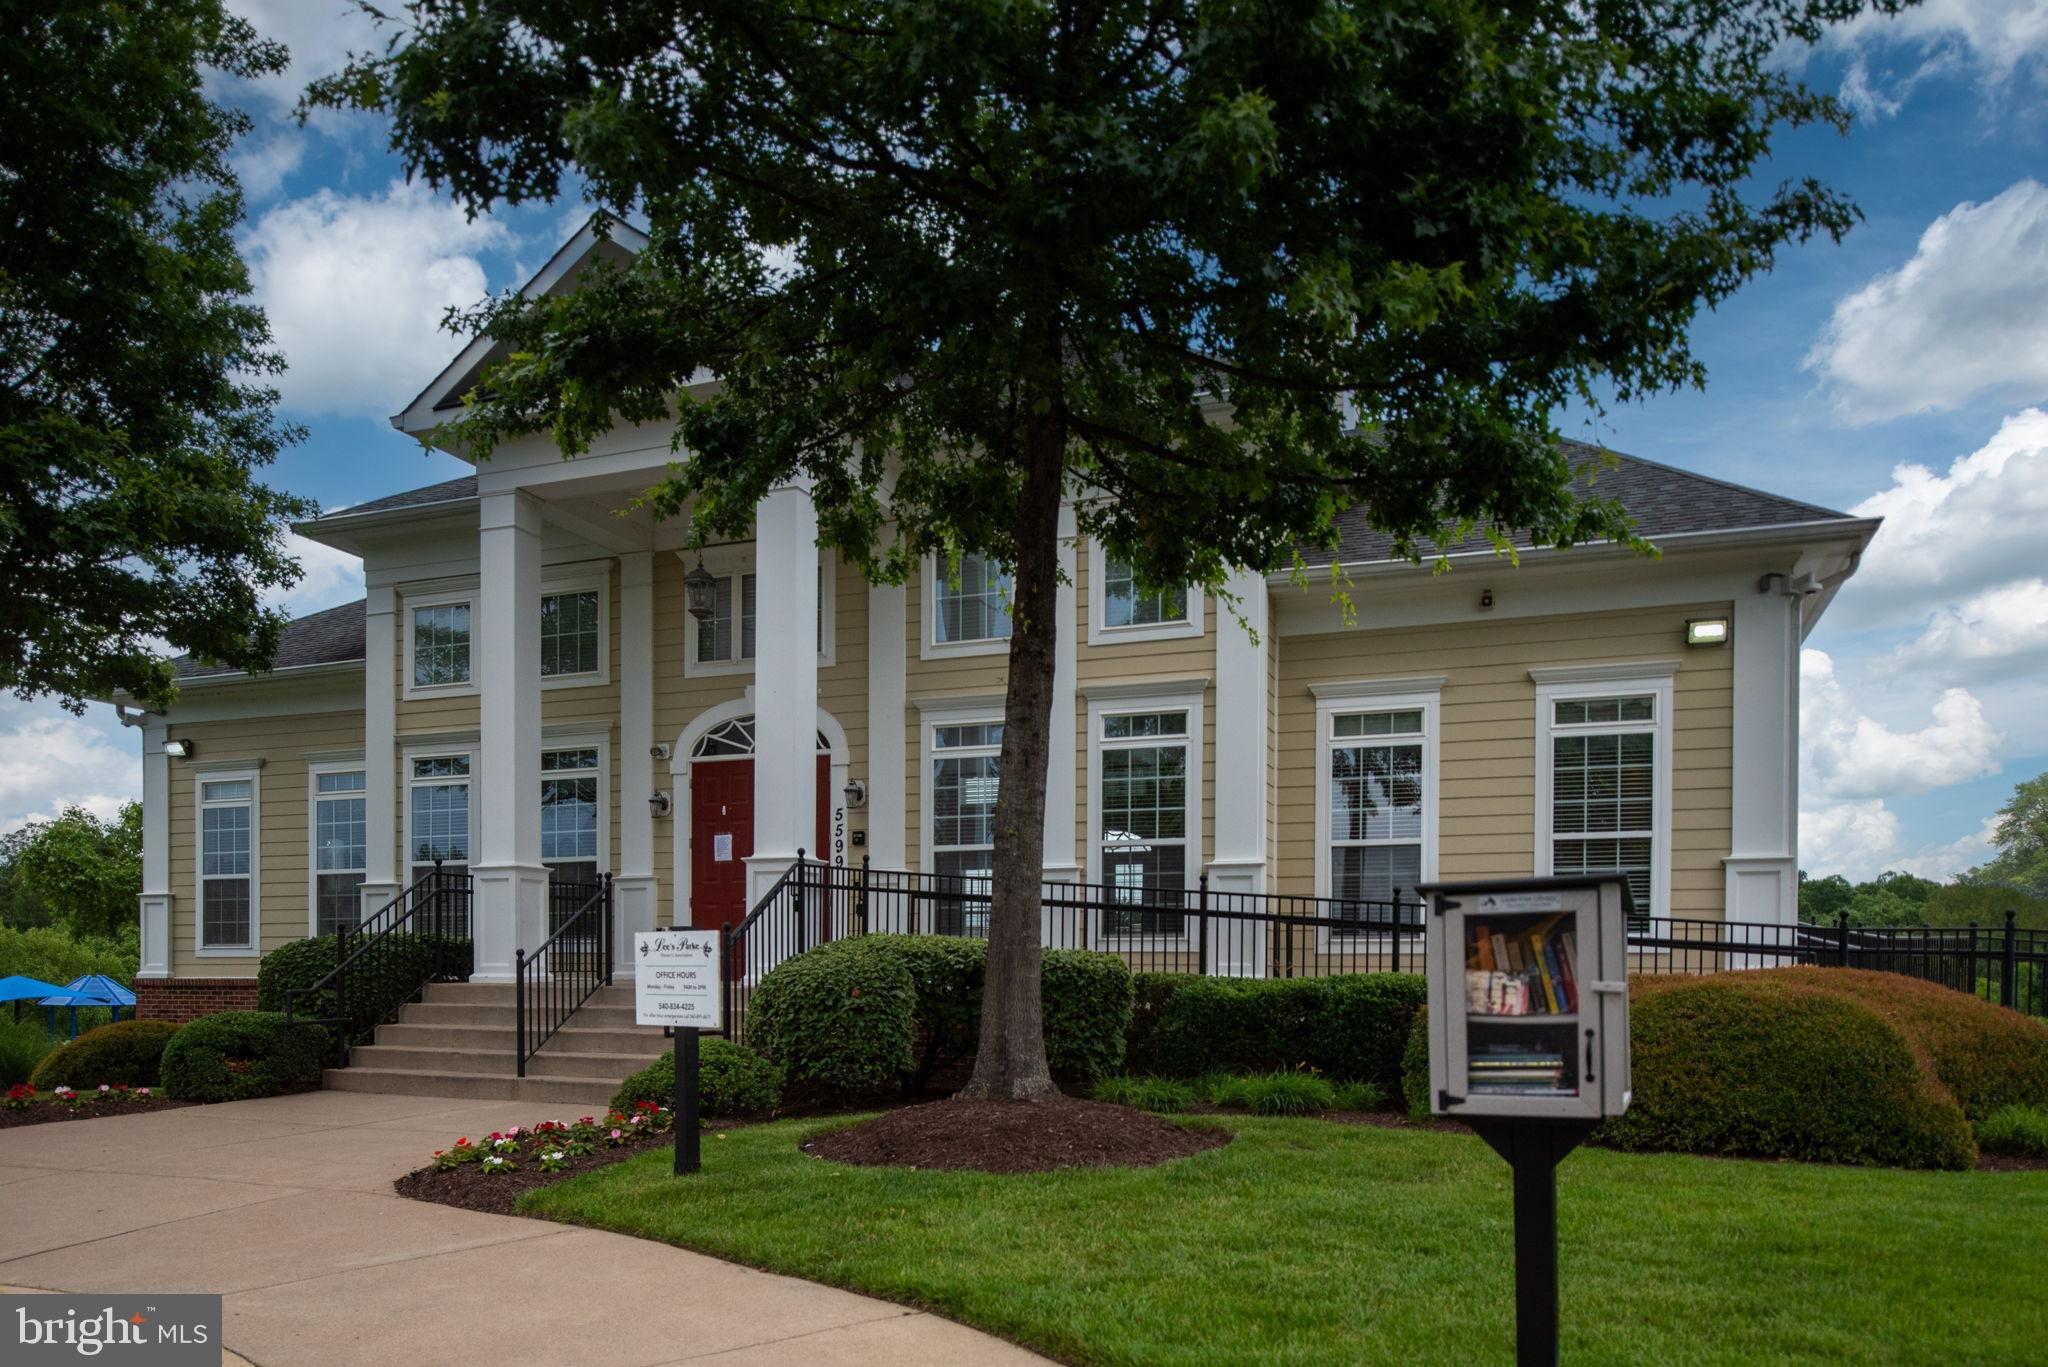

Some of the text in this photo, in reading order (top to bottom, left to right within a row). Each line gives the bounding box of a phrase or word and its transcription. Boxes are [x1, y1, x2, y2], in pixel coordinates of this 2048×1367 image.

[835, 807, 844, 868] 5599
[655, 937, 700, 952] Lee's Parke
[655, 971, 697, 980] OFFICE HOURS
